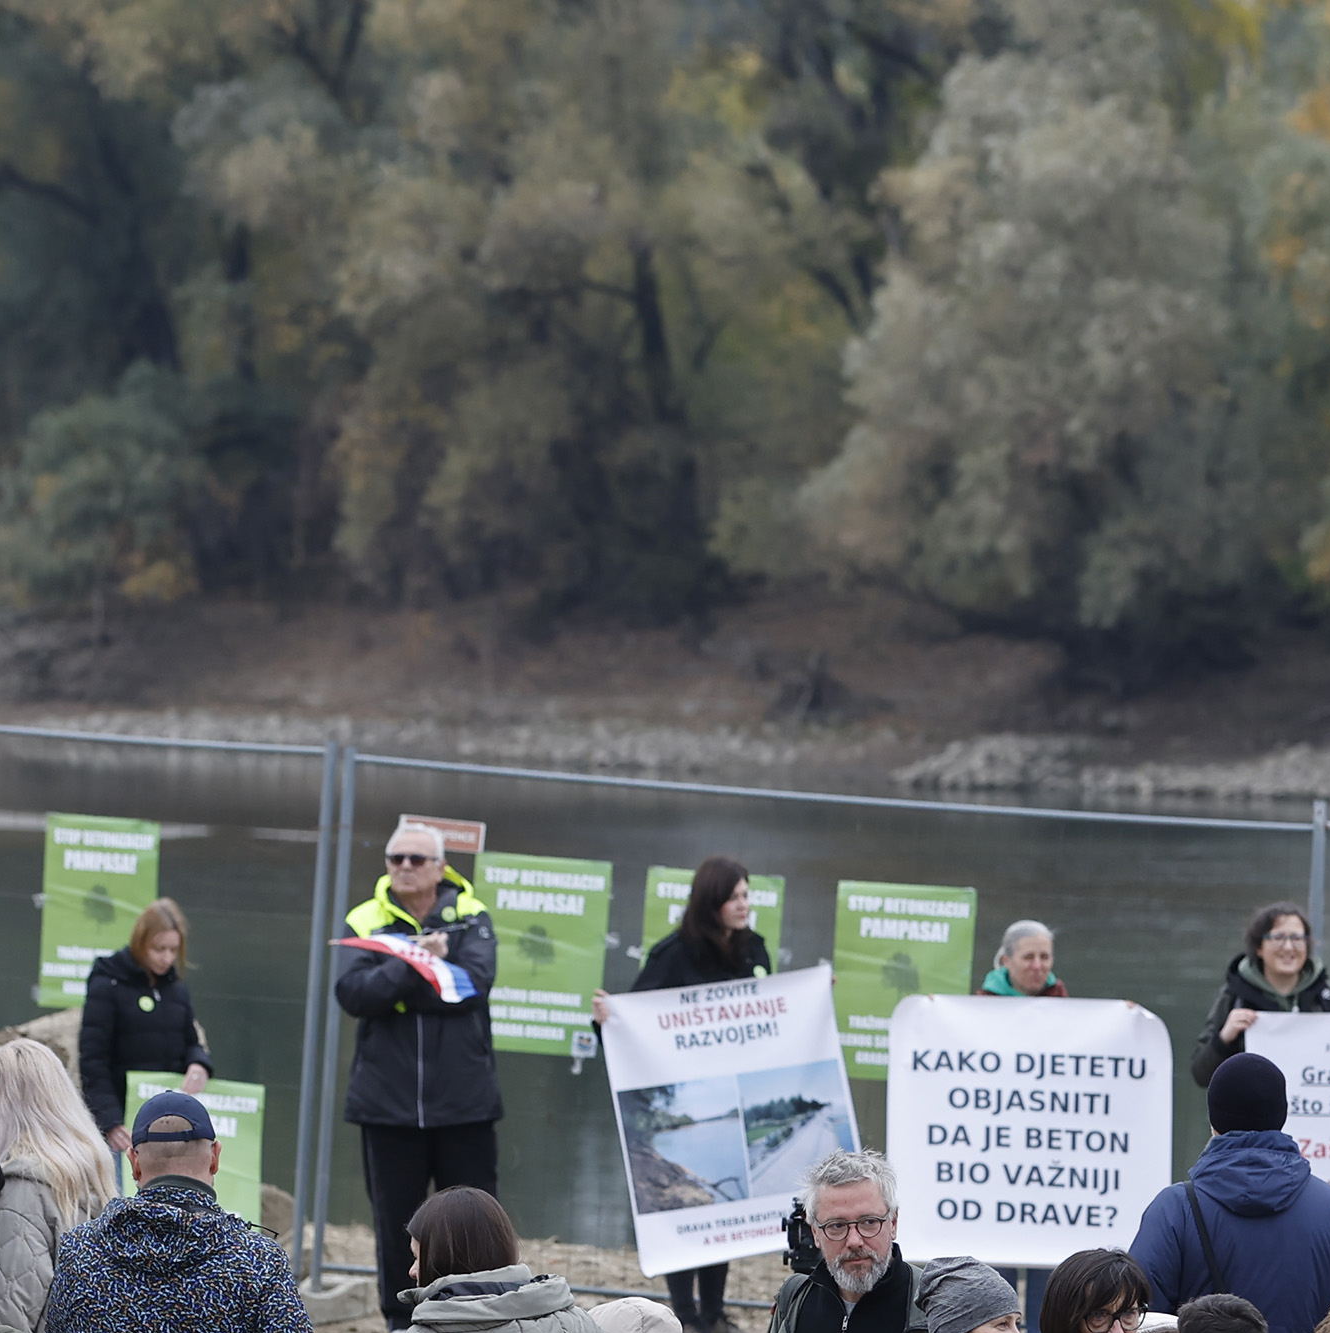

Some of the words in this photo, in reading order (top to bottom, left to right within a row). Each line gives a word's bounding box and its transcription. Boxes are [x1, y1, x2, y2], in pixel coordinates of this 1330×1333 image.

[484, 866, 519, 884] STOP
[496, 888, 586, 916] PAMPASA!
[848, 894, 882, 912] STOP
[860, 917, 950, 943] PAMPASA!
[680, 992, 699, 1005] NE
[705, 981, 759, 1001] ZOVITE
[658, 996, 788, 1031] UNIŠTAVANJE
[675, 1020, 779, 1051] RAZVOJEM!
[912, 1049, 1001, 1074] KAKO
[1015, 1052, 1148, 1080] DJETETU
[948, 1087, 1110, 1115] OBJASNITI
[1290, 1095, 1323, 1115] što
[927, 1124, 971, 1147] DA
[981, 1126, 1012, 1153] JE
[1025, 1127, 1129, 1153] BETON
[936, 1161, 990, 1185] BIO
[1002, 1159, 1120, 1196] VAŽNIJI
[937, 1198, 982, 1221] OD
[996, 1201, 1118, 1228] DRAVE?
